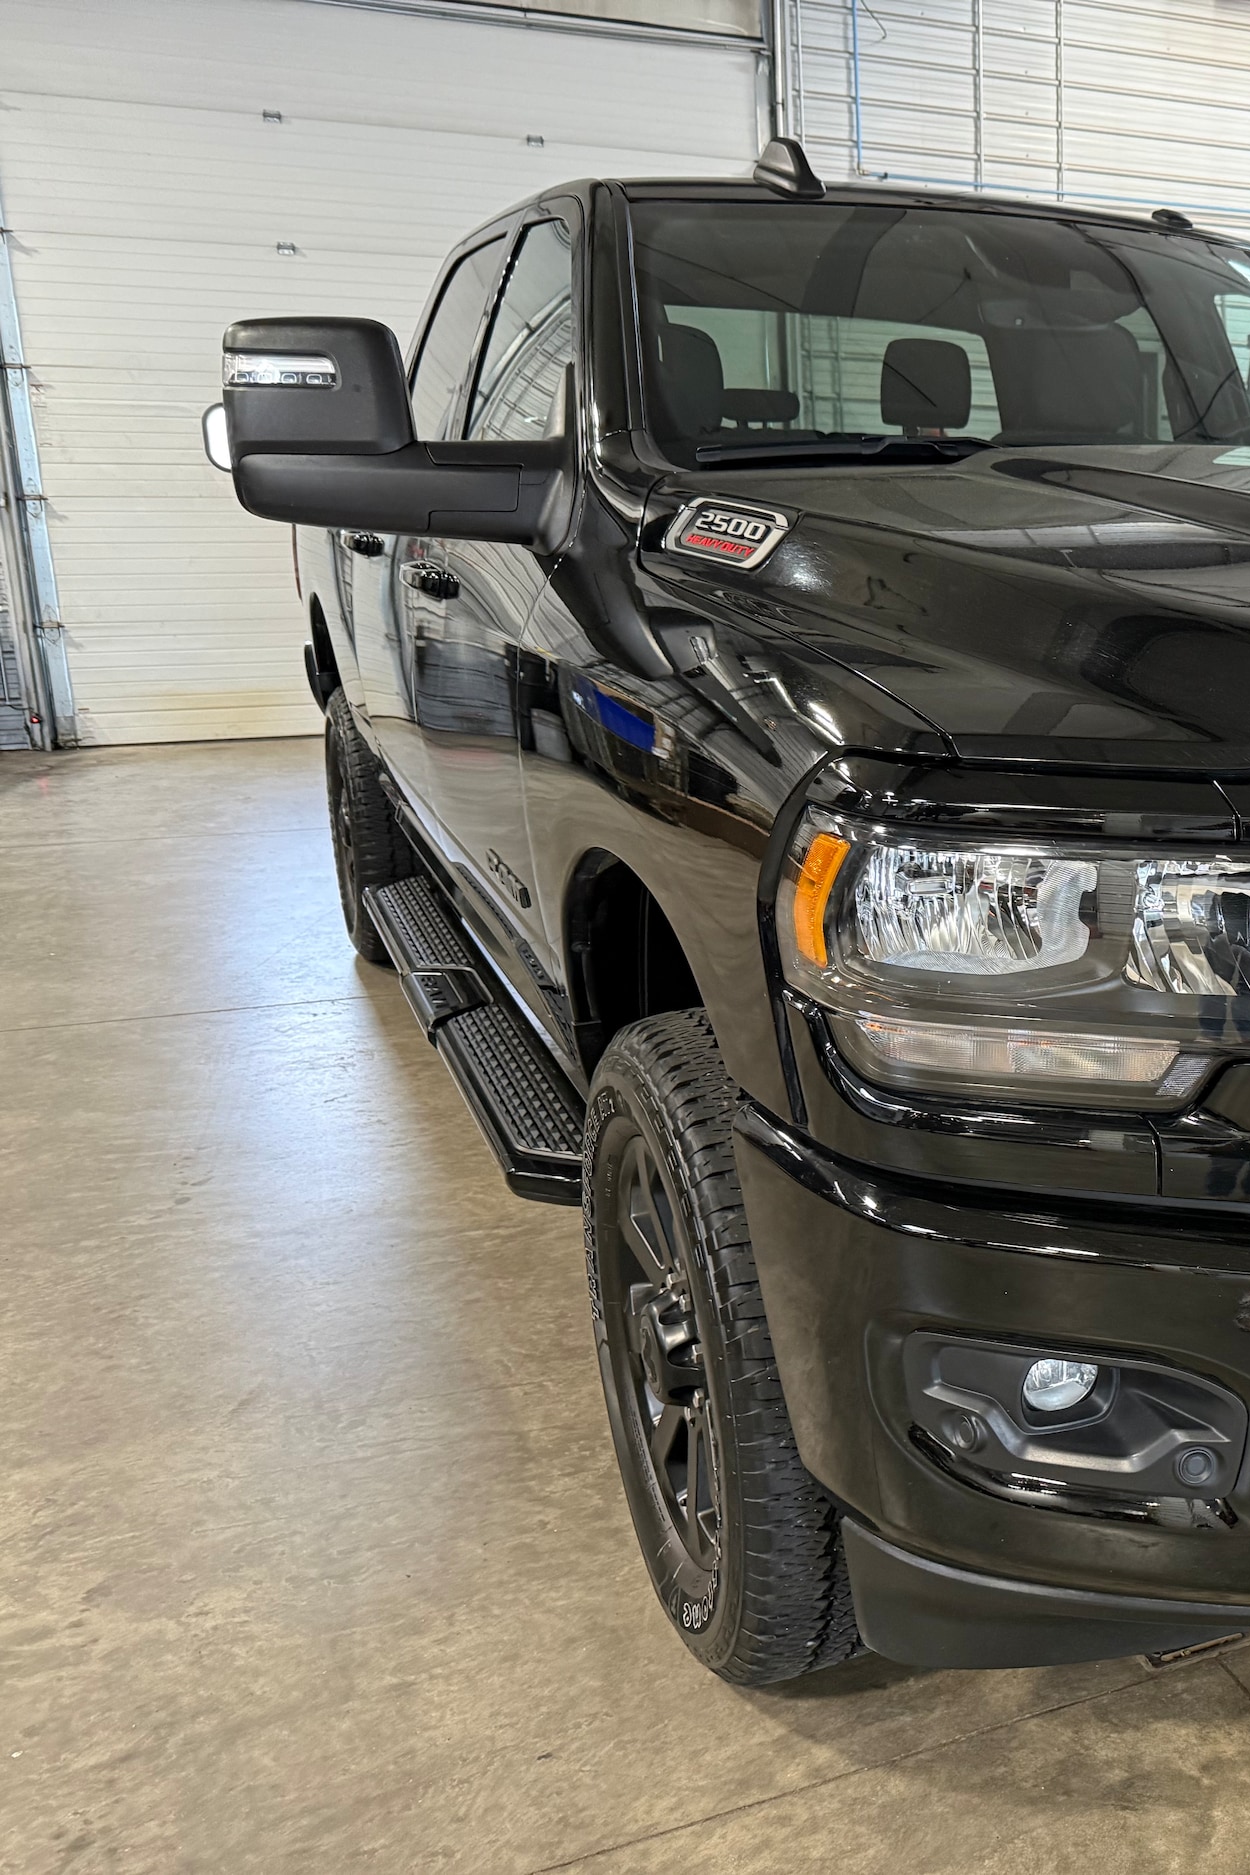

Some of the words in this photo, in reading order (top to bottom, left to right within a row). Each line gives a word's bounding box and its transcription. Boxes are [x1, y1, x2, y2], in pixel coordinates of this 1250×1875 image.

[695, 512, 766, 540] 2500
[685, 533, 722, 549] HEAVY
[720, 541, 756, 557] DUTY
[582, 1107, 602, 1321] TRANSFORCE
